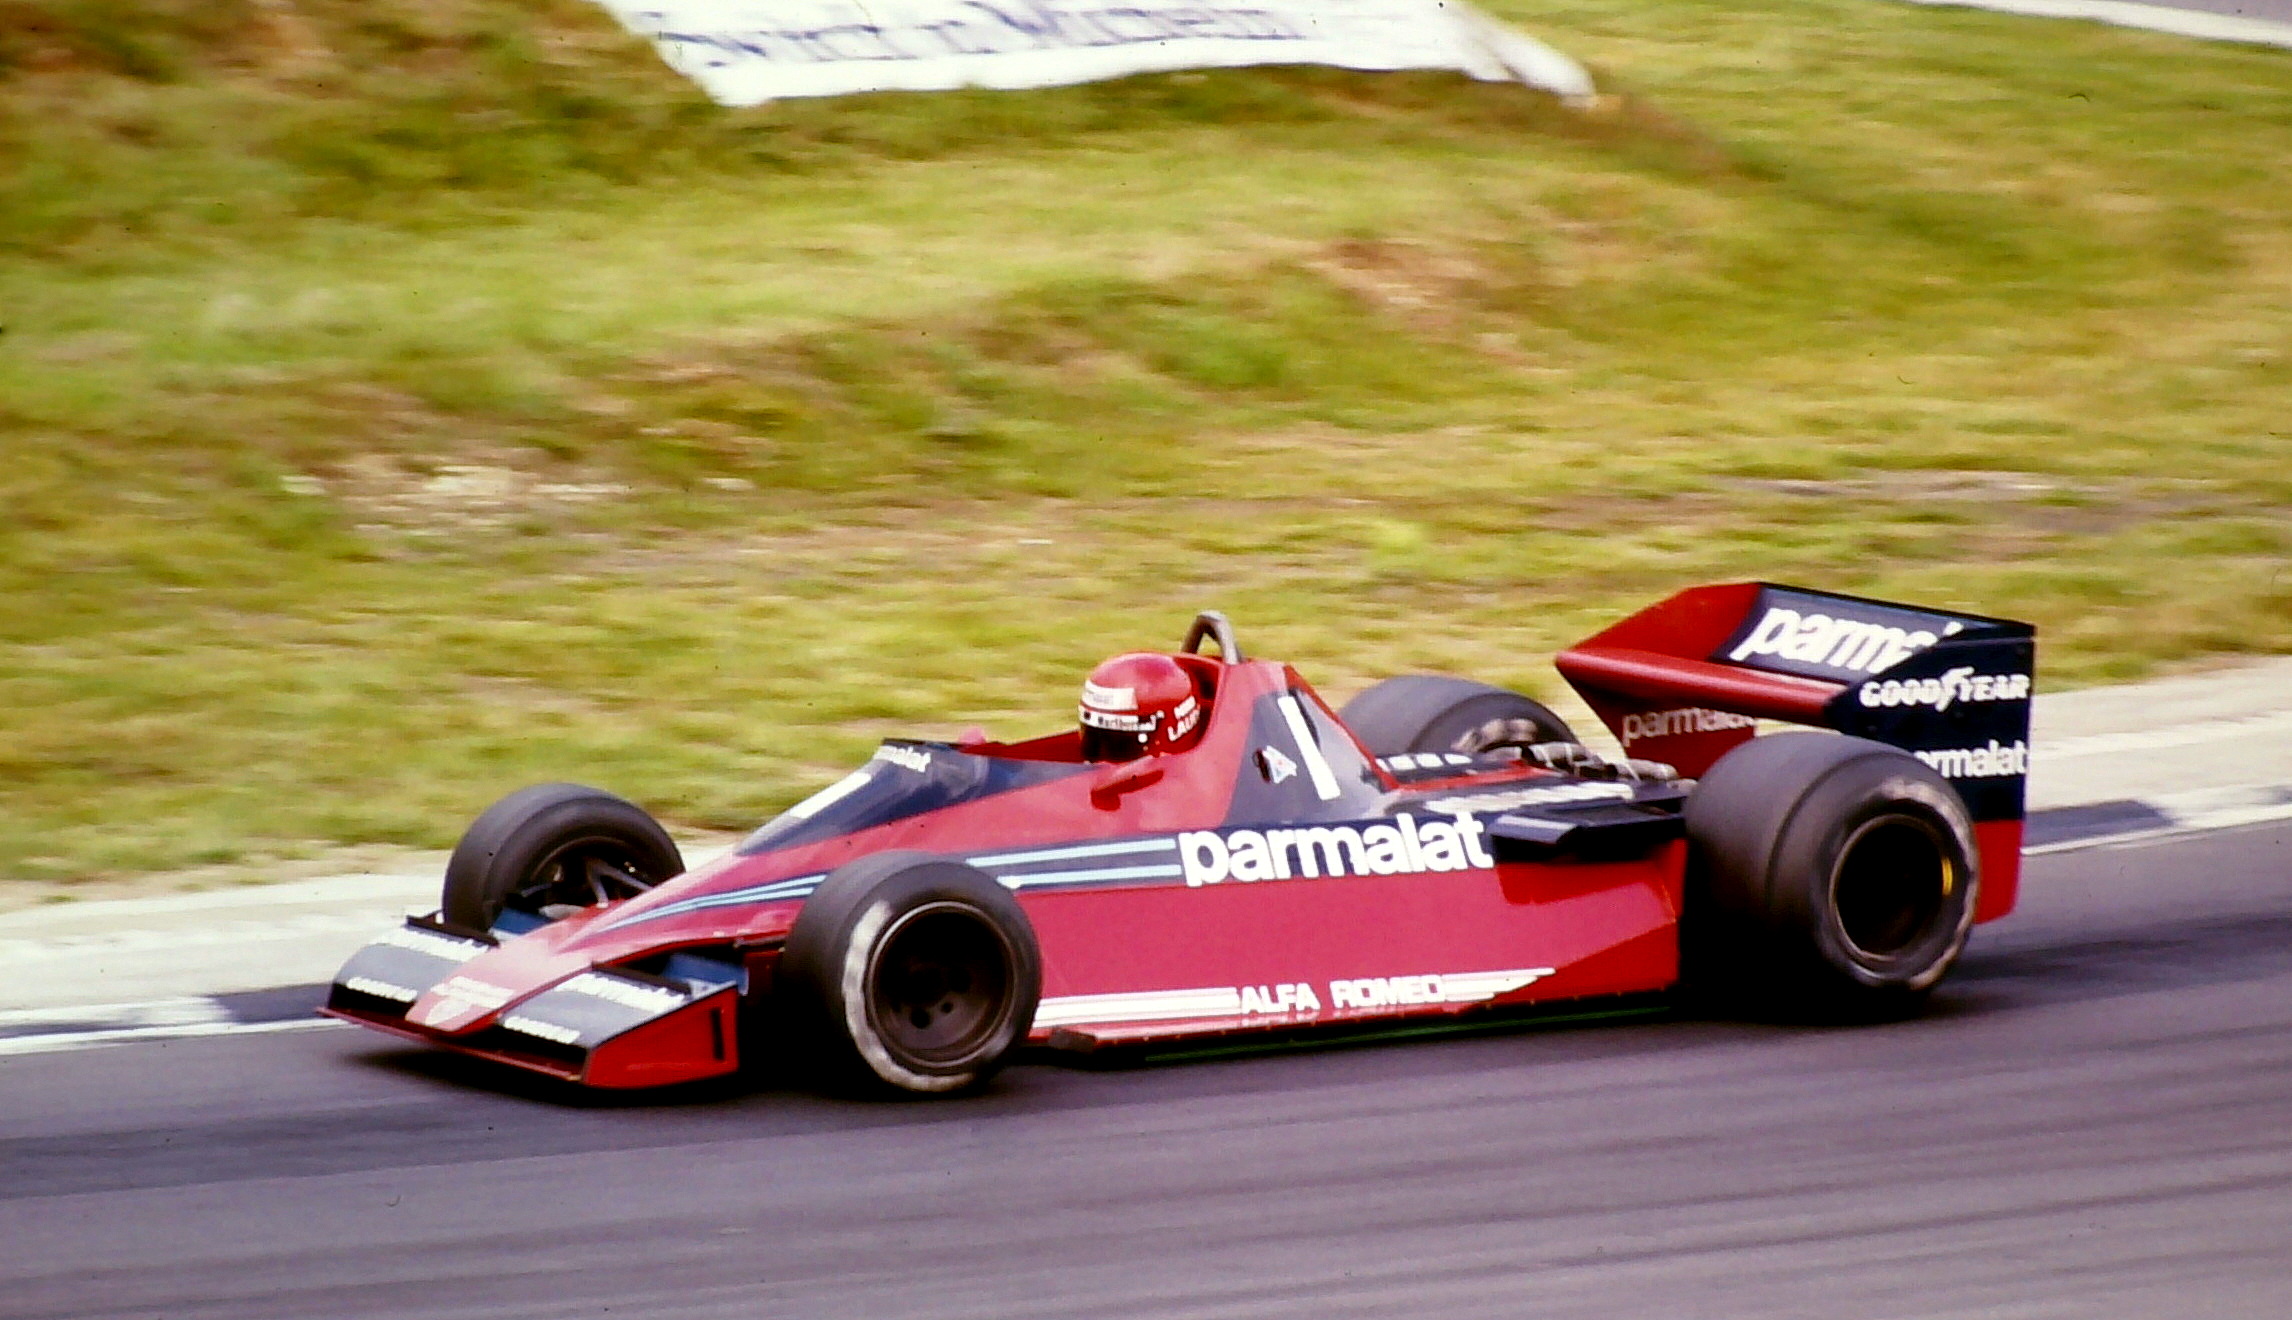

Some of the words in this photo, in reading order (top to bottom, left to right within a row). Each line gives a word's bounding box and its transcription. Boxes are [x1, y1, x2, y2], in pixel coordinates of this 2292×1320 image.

[1729, 607, 1964, 674] parma
[1859, 666, 2030, 712] GOODYEAR
[1913, 739, 2028, 778] rmalat
[1179, 811, 1494, 888] parmalat
[1241, 982, 1321, 1014] ALFA
[1329, 974, 1446, 1009] ROMEO
